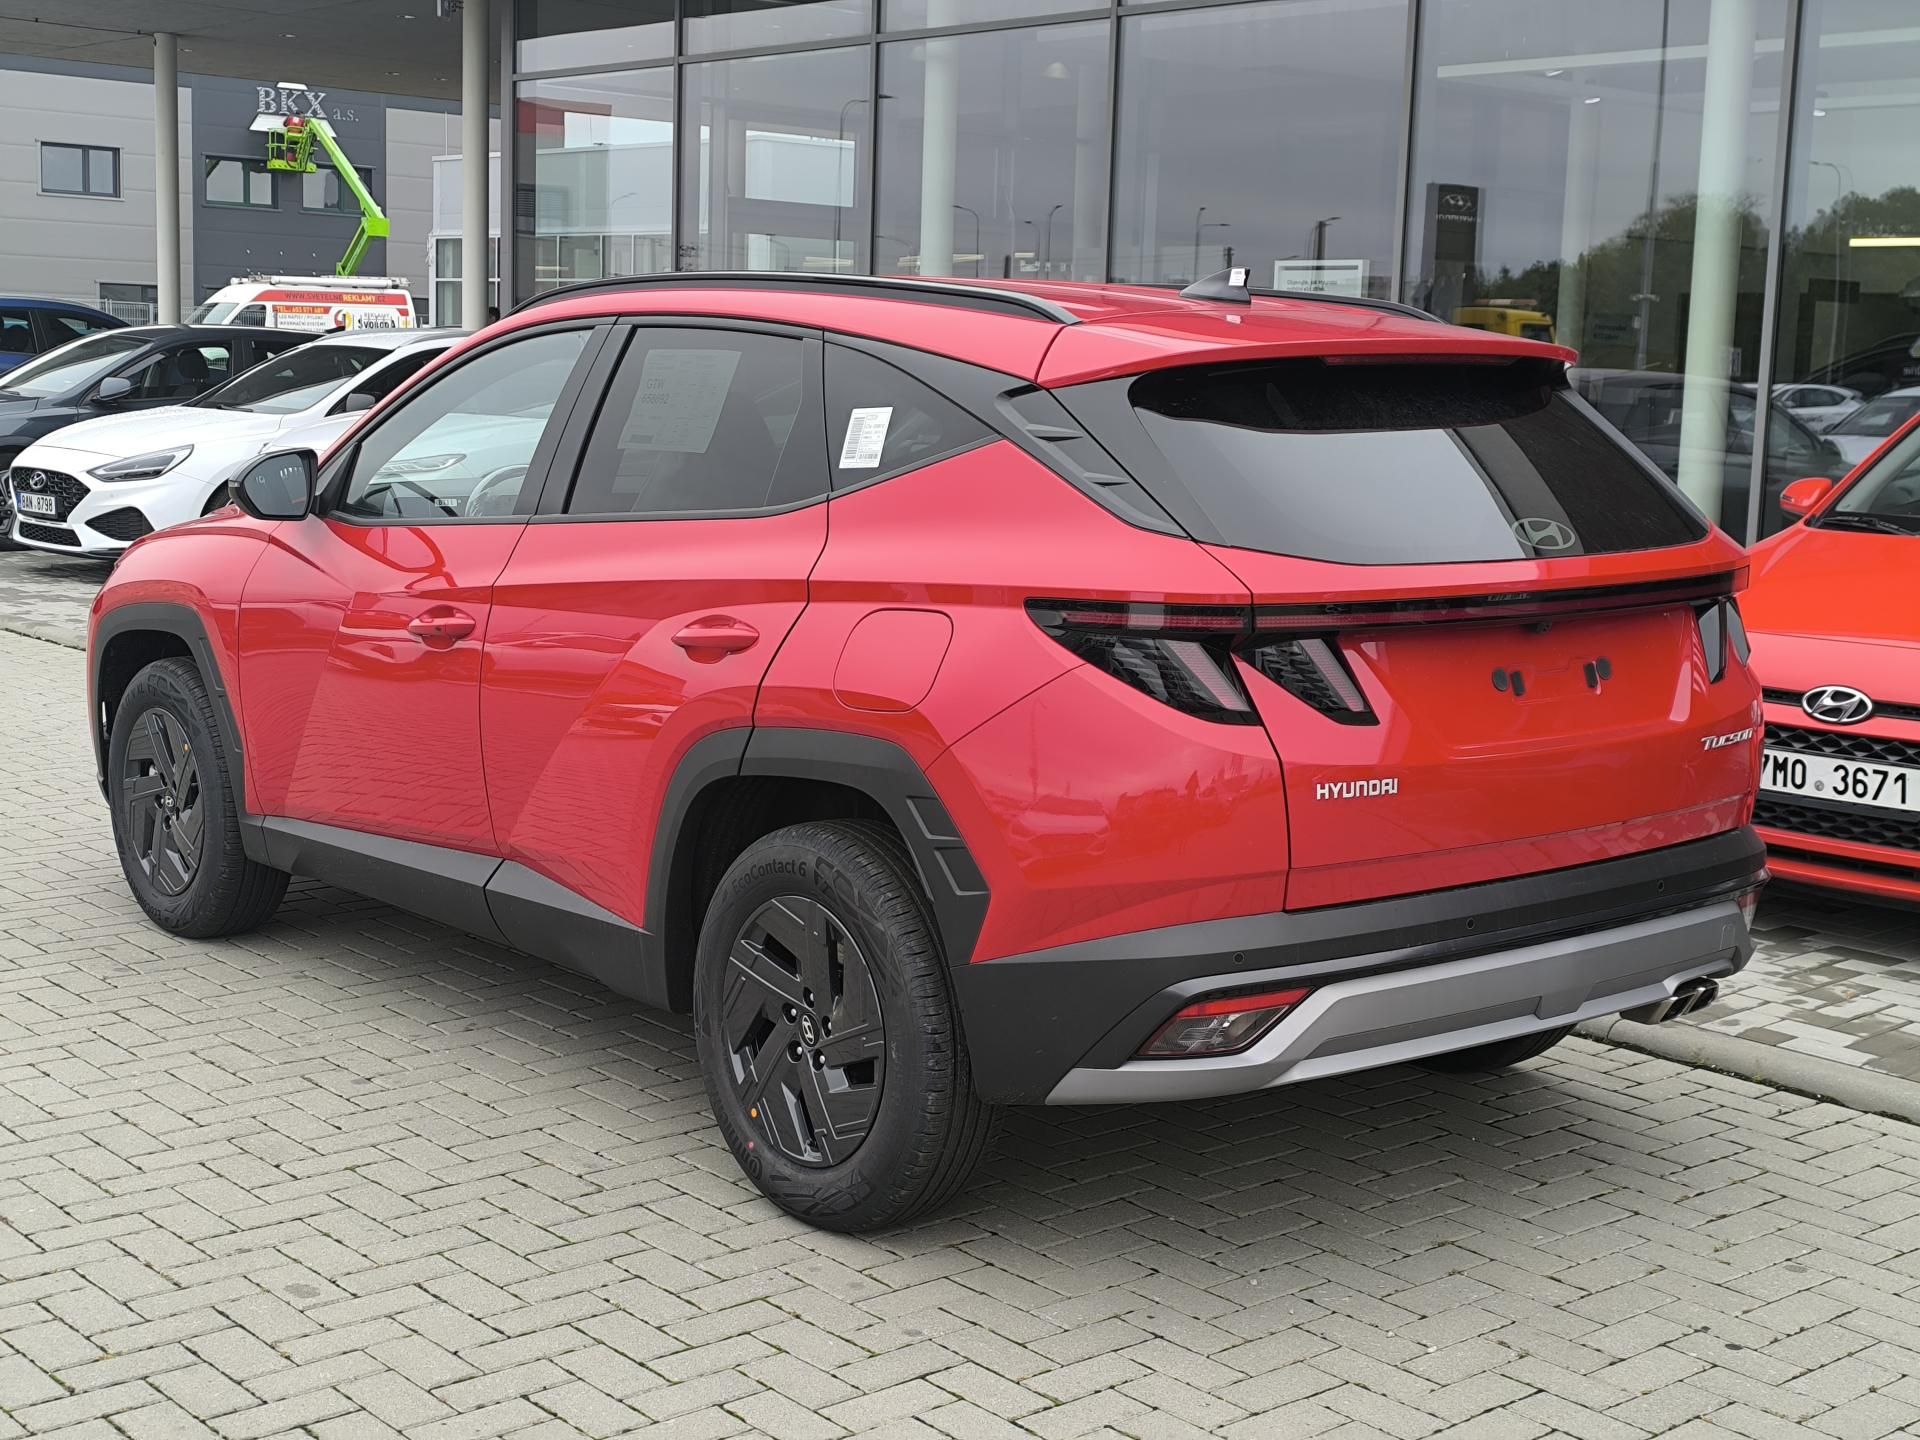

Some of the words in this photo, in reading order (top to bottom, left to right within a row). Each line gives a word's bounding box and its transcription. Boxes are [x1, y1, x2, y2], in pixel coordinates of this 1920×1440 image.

[256, 87, 327, 118] BKX
[333, 106, 359, 122] a.s.
[1316, 778, 1399, 800] HYUNDAI
[1832, 764, 1908, 804] 3671
